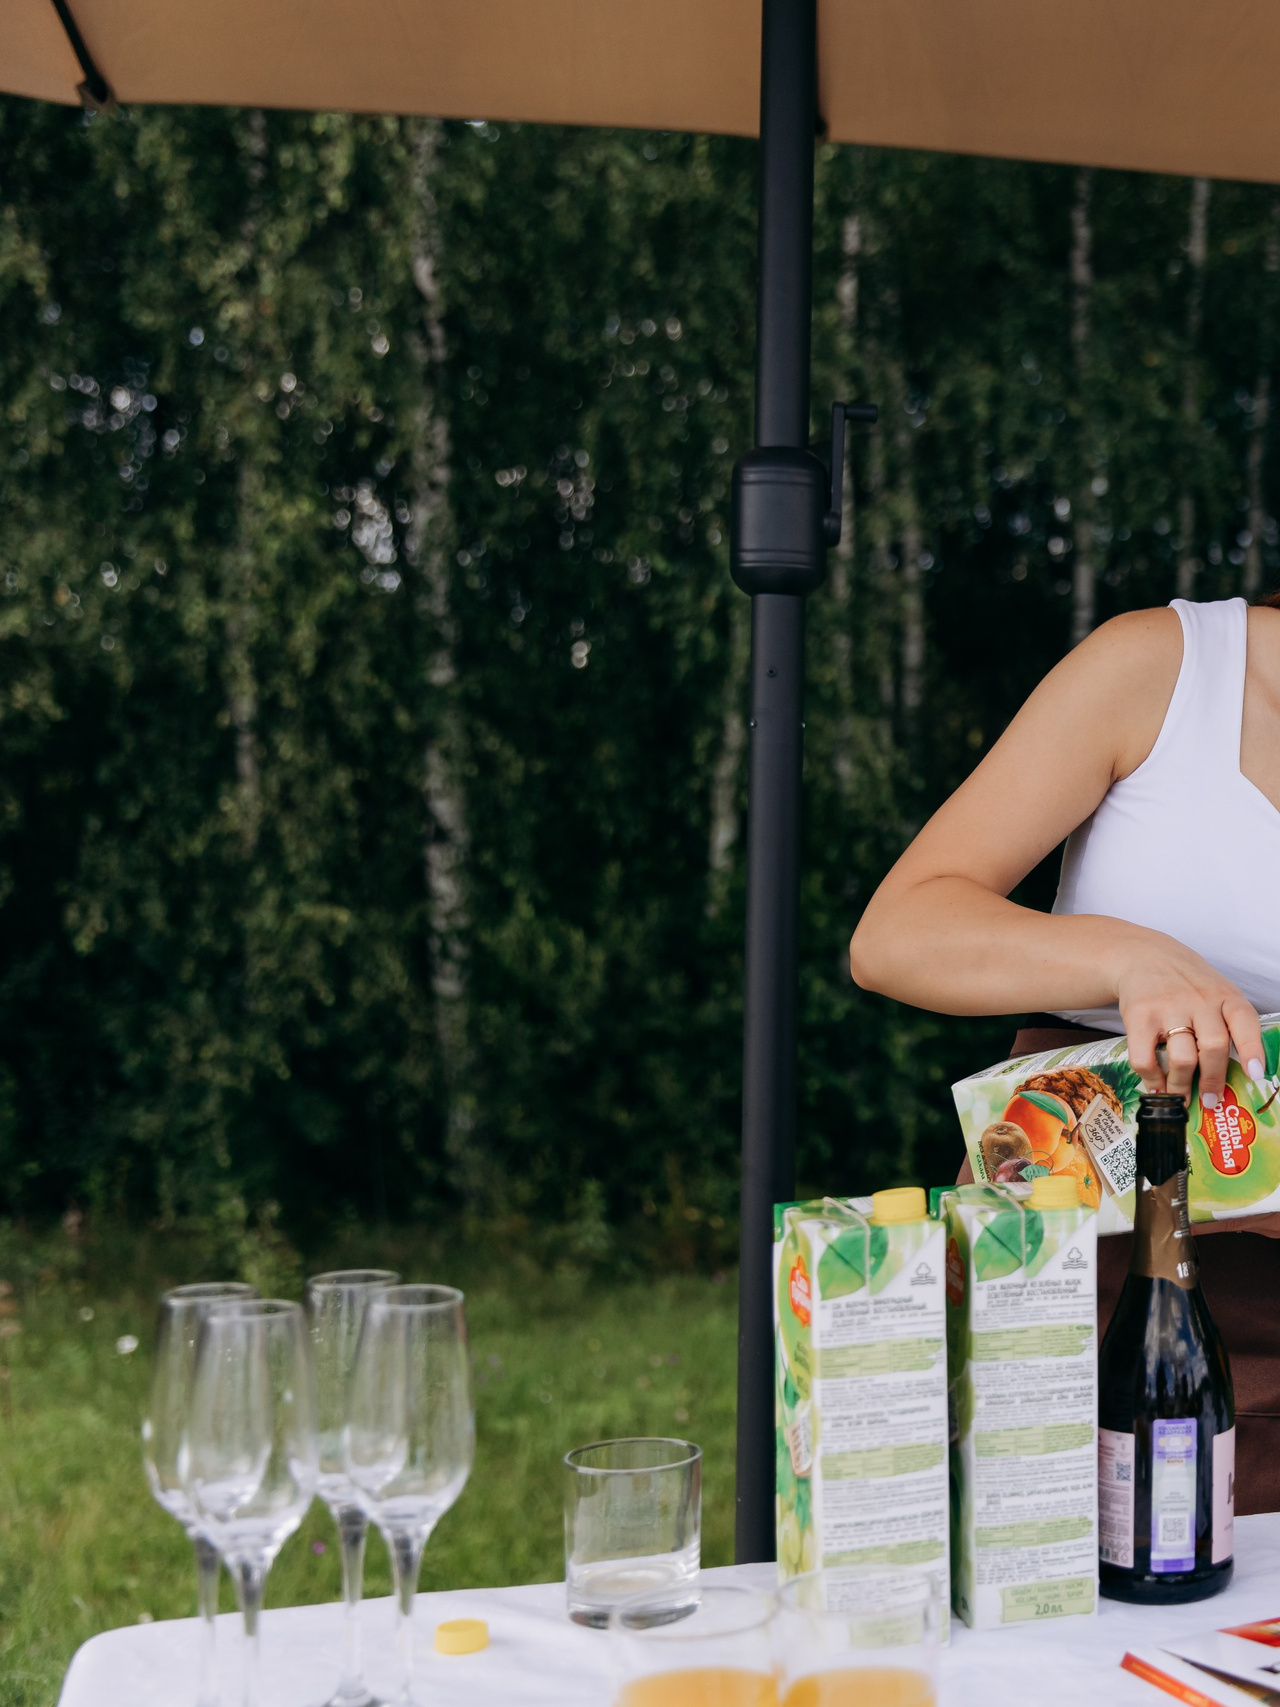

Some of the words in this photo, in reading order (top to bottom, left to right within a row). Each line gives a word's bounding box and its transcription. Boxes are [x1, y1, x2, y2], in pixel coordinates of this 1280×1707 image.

[1093, 1117, 1114, 1144] Придонья
[1101, 1118, 1115, 1135] Садах
[1213, 1097, 1236, 1168] ридонья
[1225, 1104, 1244, 1149] Сады
[1035, 1603, 1050, 1616] 2,0
